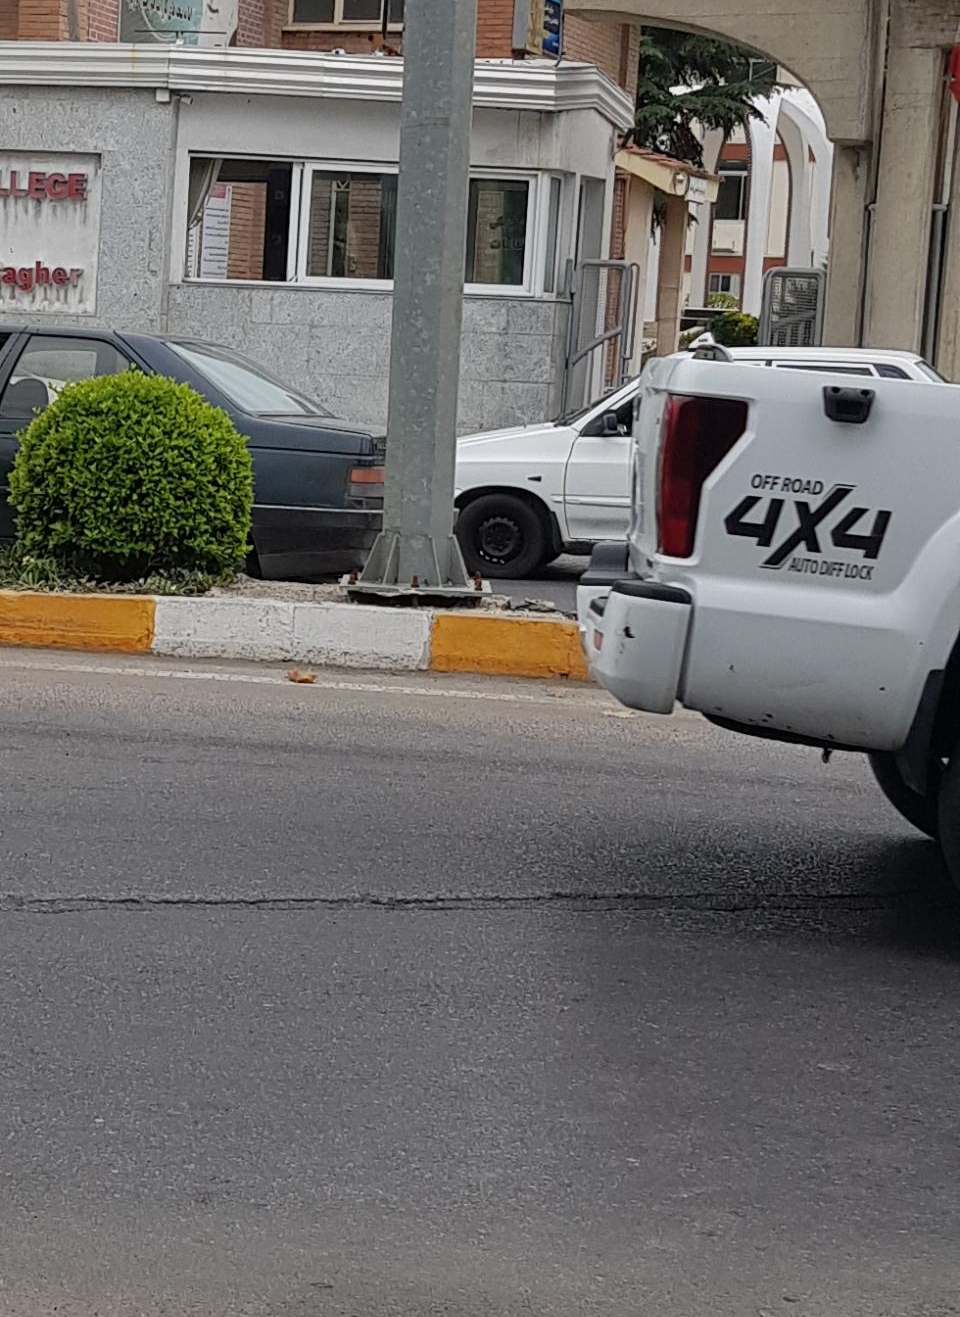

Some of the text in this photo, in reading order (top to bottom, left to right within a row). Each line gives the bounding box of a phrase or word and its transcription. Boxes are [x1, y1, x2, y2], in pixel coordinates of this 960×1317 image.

[750, 474, 825, 495] OFF ROAD
[724, 483, 893, 571] 4X4
[788, 557, 875, 581] AUTO DIFF LOCK
